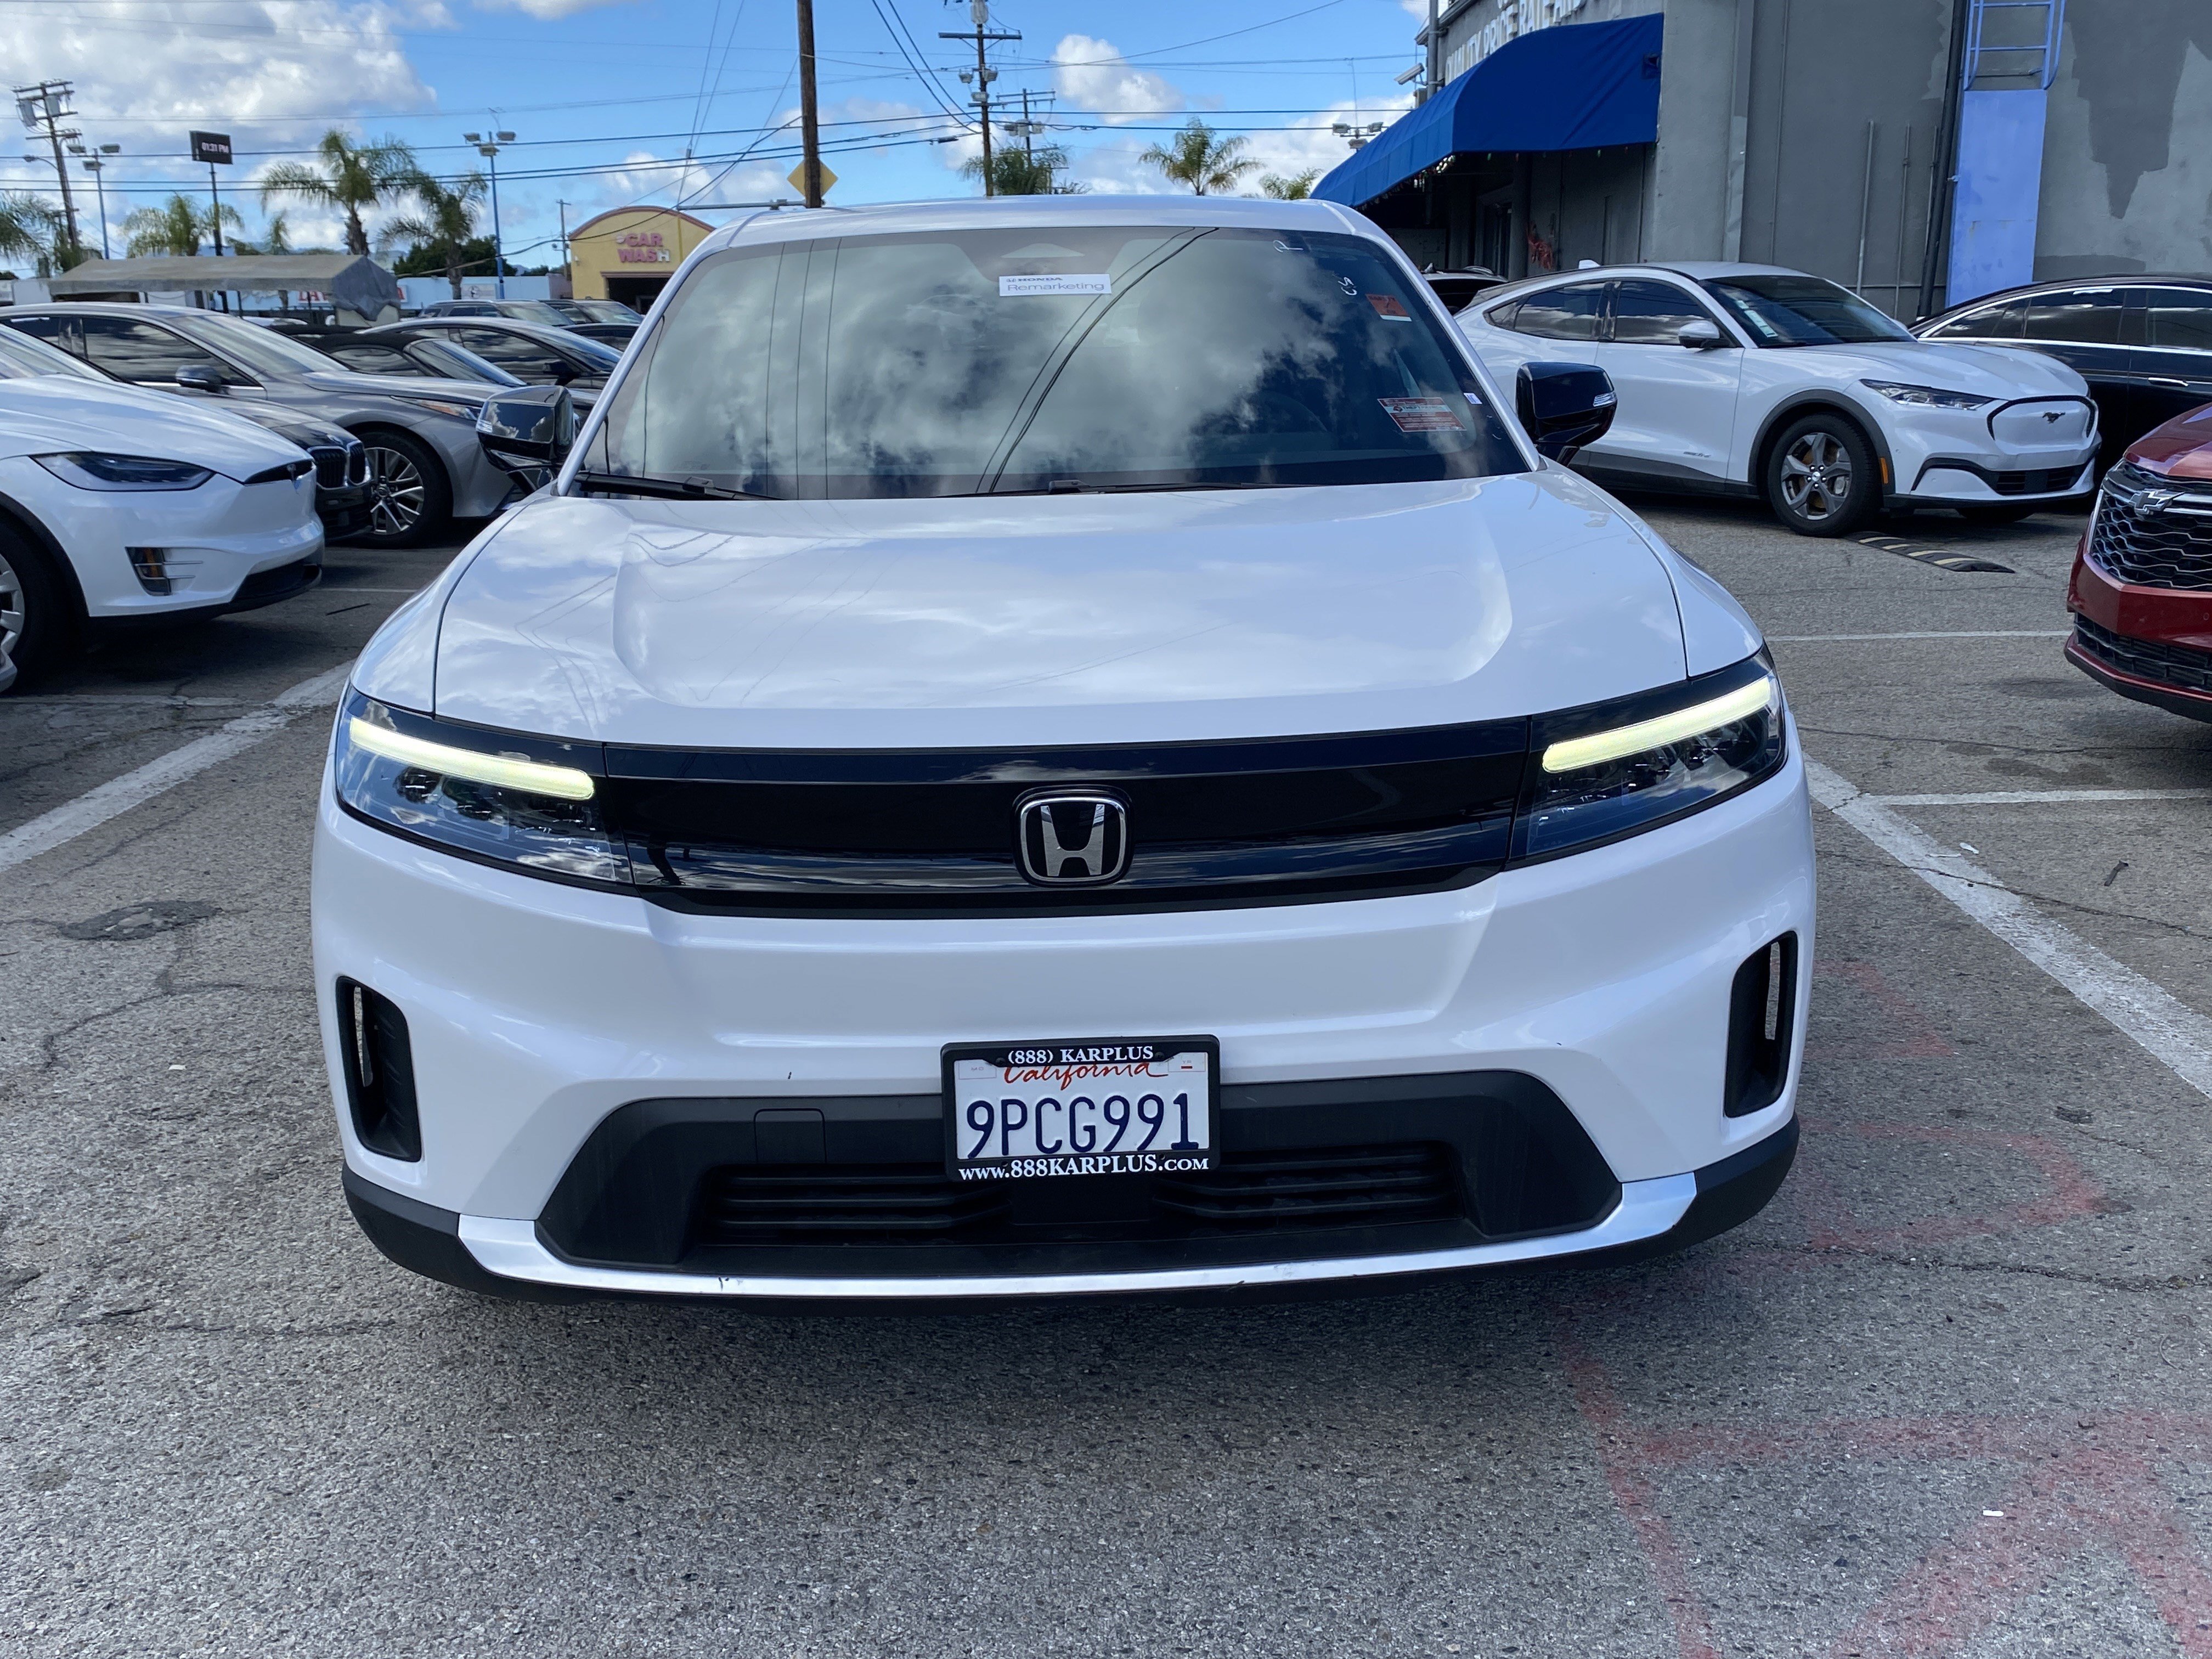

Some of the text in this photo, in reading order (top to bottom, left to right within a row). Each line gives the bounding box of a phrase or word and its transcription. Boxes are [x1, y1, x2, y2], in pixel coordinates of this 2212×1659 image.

[625, 233, 663, 246] CAR
[617, 249, 670, 262] WASH
[1007, 283, 1104, 291] Remarketing
[1008, 1046, 1153, 1064] (888) KARPLUS
[967, 1093, 1199, 1159] 9PCG991
